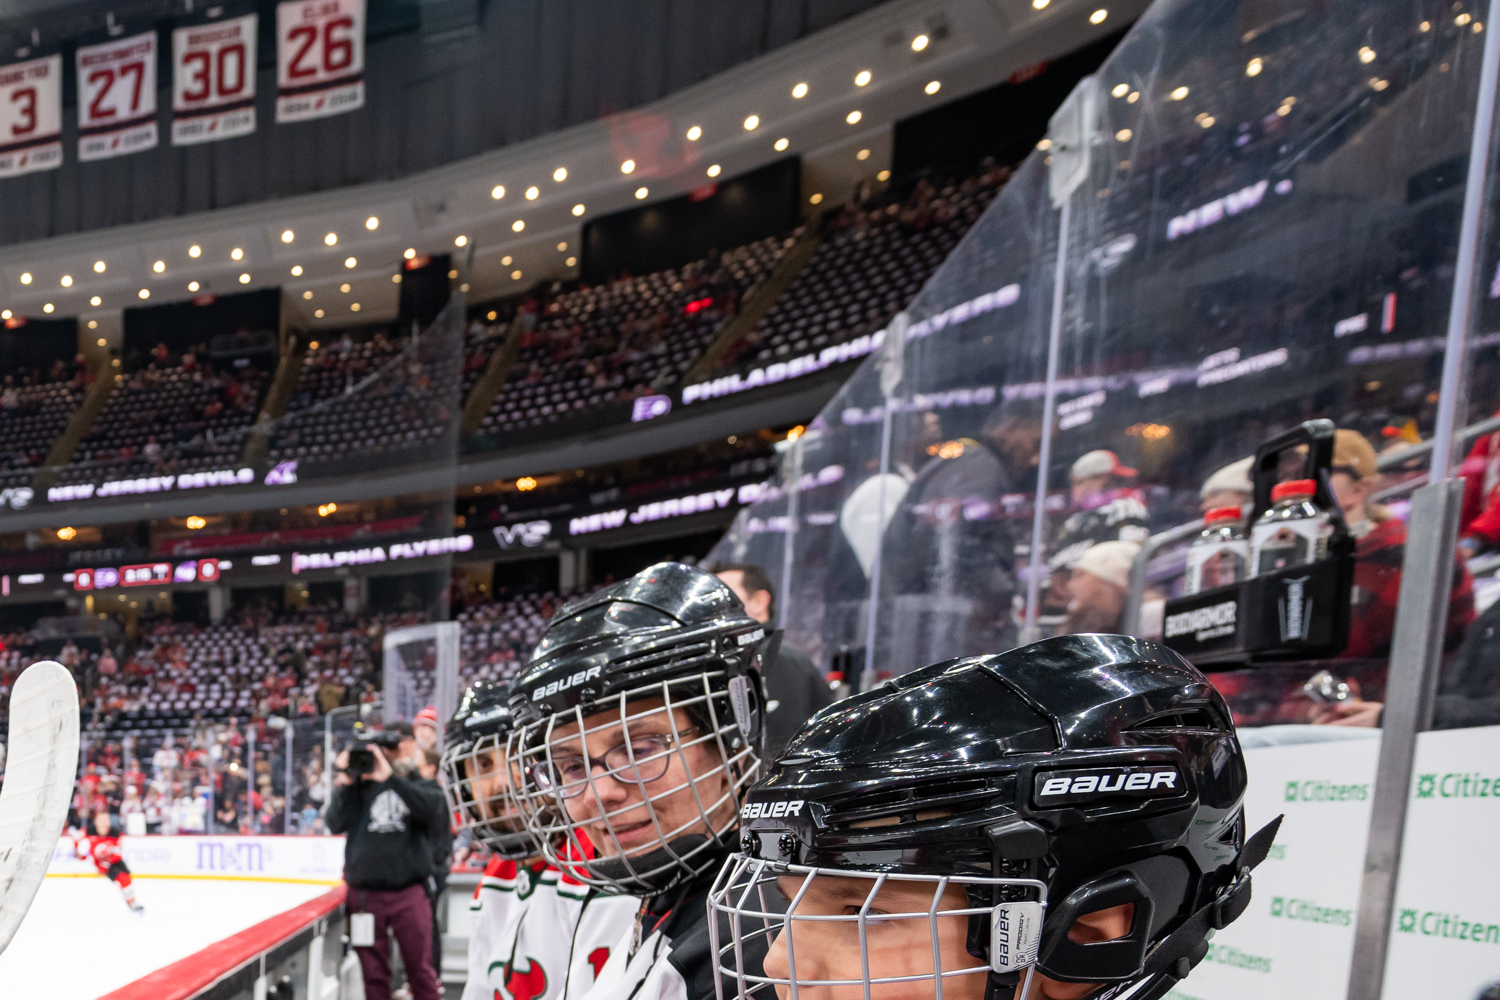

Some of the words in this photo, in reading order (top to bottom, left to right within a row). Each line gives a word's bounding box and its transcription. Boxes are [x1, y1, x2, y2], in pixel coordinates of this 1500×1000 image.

[287, 16, 353, 80] 26
[88, 61, 144, 120] 27
[182, 43, 246, 103] 30
[11, 87, 37, 135] 3
[48, 483, 94, 502] NEW
[96, 474, 176, 498] JERSEY
[177, 467, 255, 491] DEVILS
[493, 519, 552, 549] VS
[569, 508, 629, 536] NEW
[629, 488, 736, 525] JERSEY
[388, 534, 475, 560] FLYERS
[532, 665, 602, 702] BAUER
[1040, 771, 1177, 796] BAUER
[1300, 779, 1370, 803] Citizens
[741, 800, 805, 819] BAUER
[1285, 897, 1352, 927] Citizens
[1000, 908, 1009, 967] BAUER
[1016, 912, 1025, 950] PRODIGY
[1216, 945, 1272, 973] Citizens
